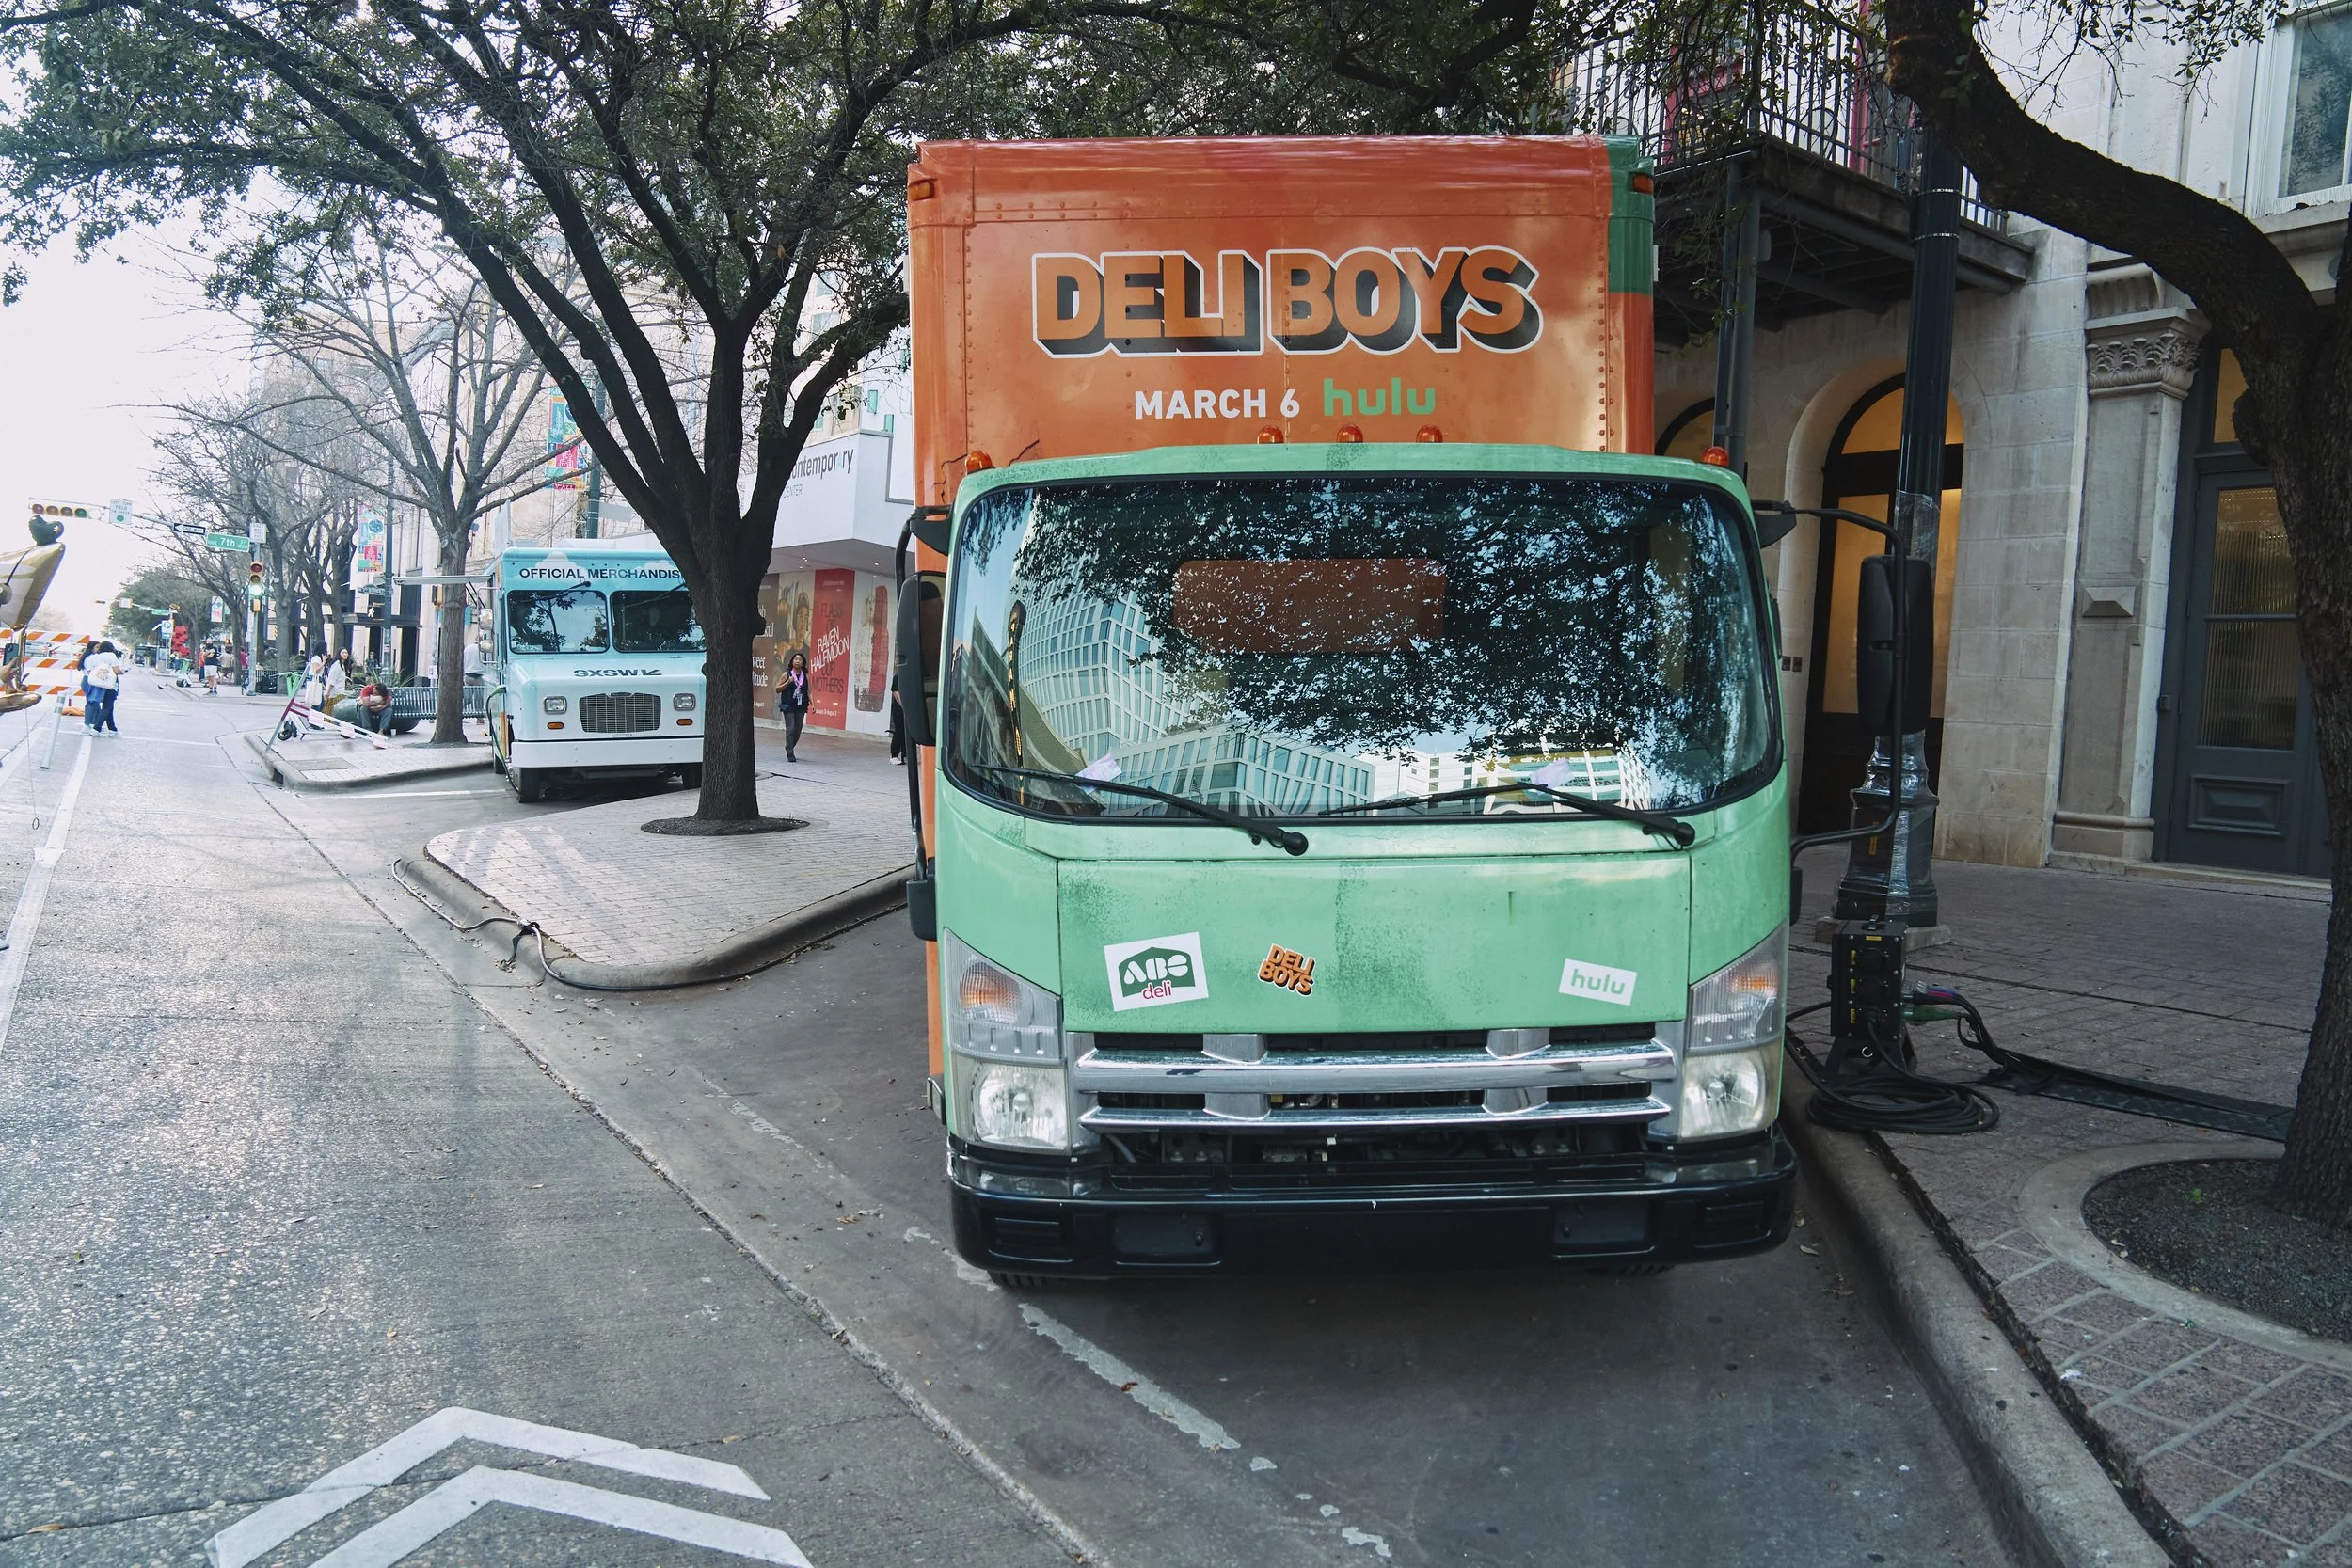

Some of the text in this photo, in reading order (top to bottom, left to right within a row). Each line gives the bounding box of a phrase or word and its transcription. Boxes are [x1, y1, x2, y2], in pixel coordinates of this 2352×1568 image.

[1032, 245, 1544, 358] DELI BOYS
[1135, 378, 1436, 420] MARCH 6 hulu
[790, 449, 854, 480] ontemporary
[220, 537, 235, 547] 7th
[519, 568, 680, 578] OFFICIAL MERCHANDIS
[817, 625, 840, 654] RAVEN
[752, 656, 766, 669] weet
[810, 634, 850, 674] HALFMOON
[573, 669, 638, 677] SXSW
[810, 676, 845, 694] MOTHERS
[1266, 943, 1315, 975] DELI
[1142, 981, 1172, 1000] deli
[1258, 959, 1315, 996] BOYS
[1570, 967, 1626, 994] hulu
